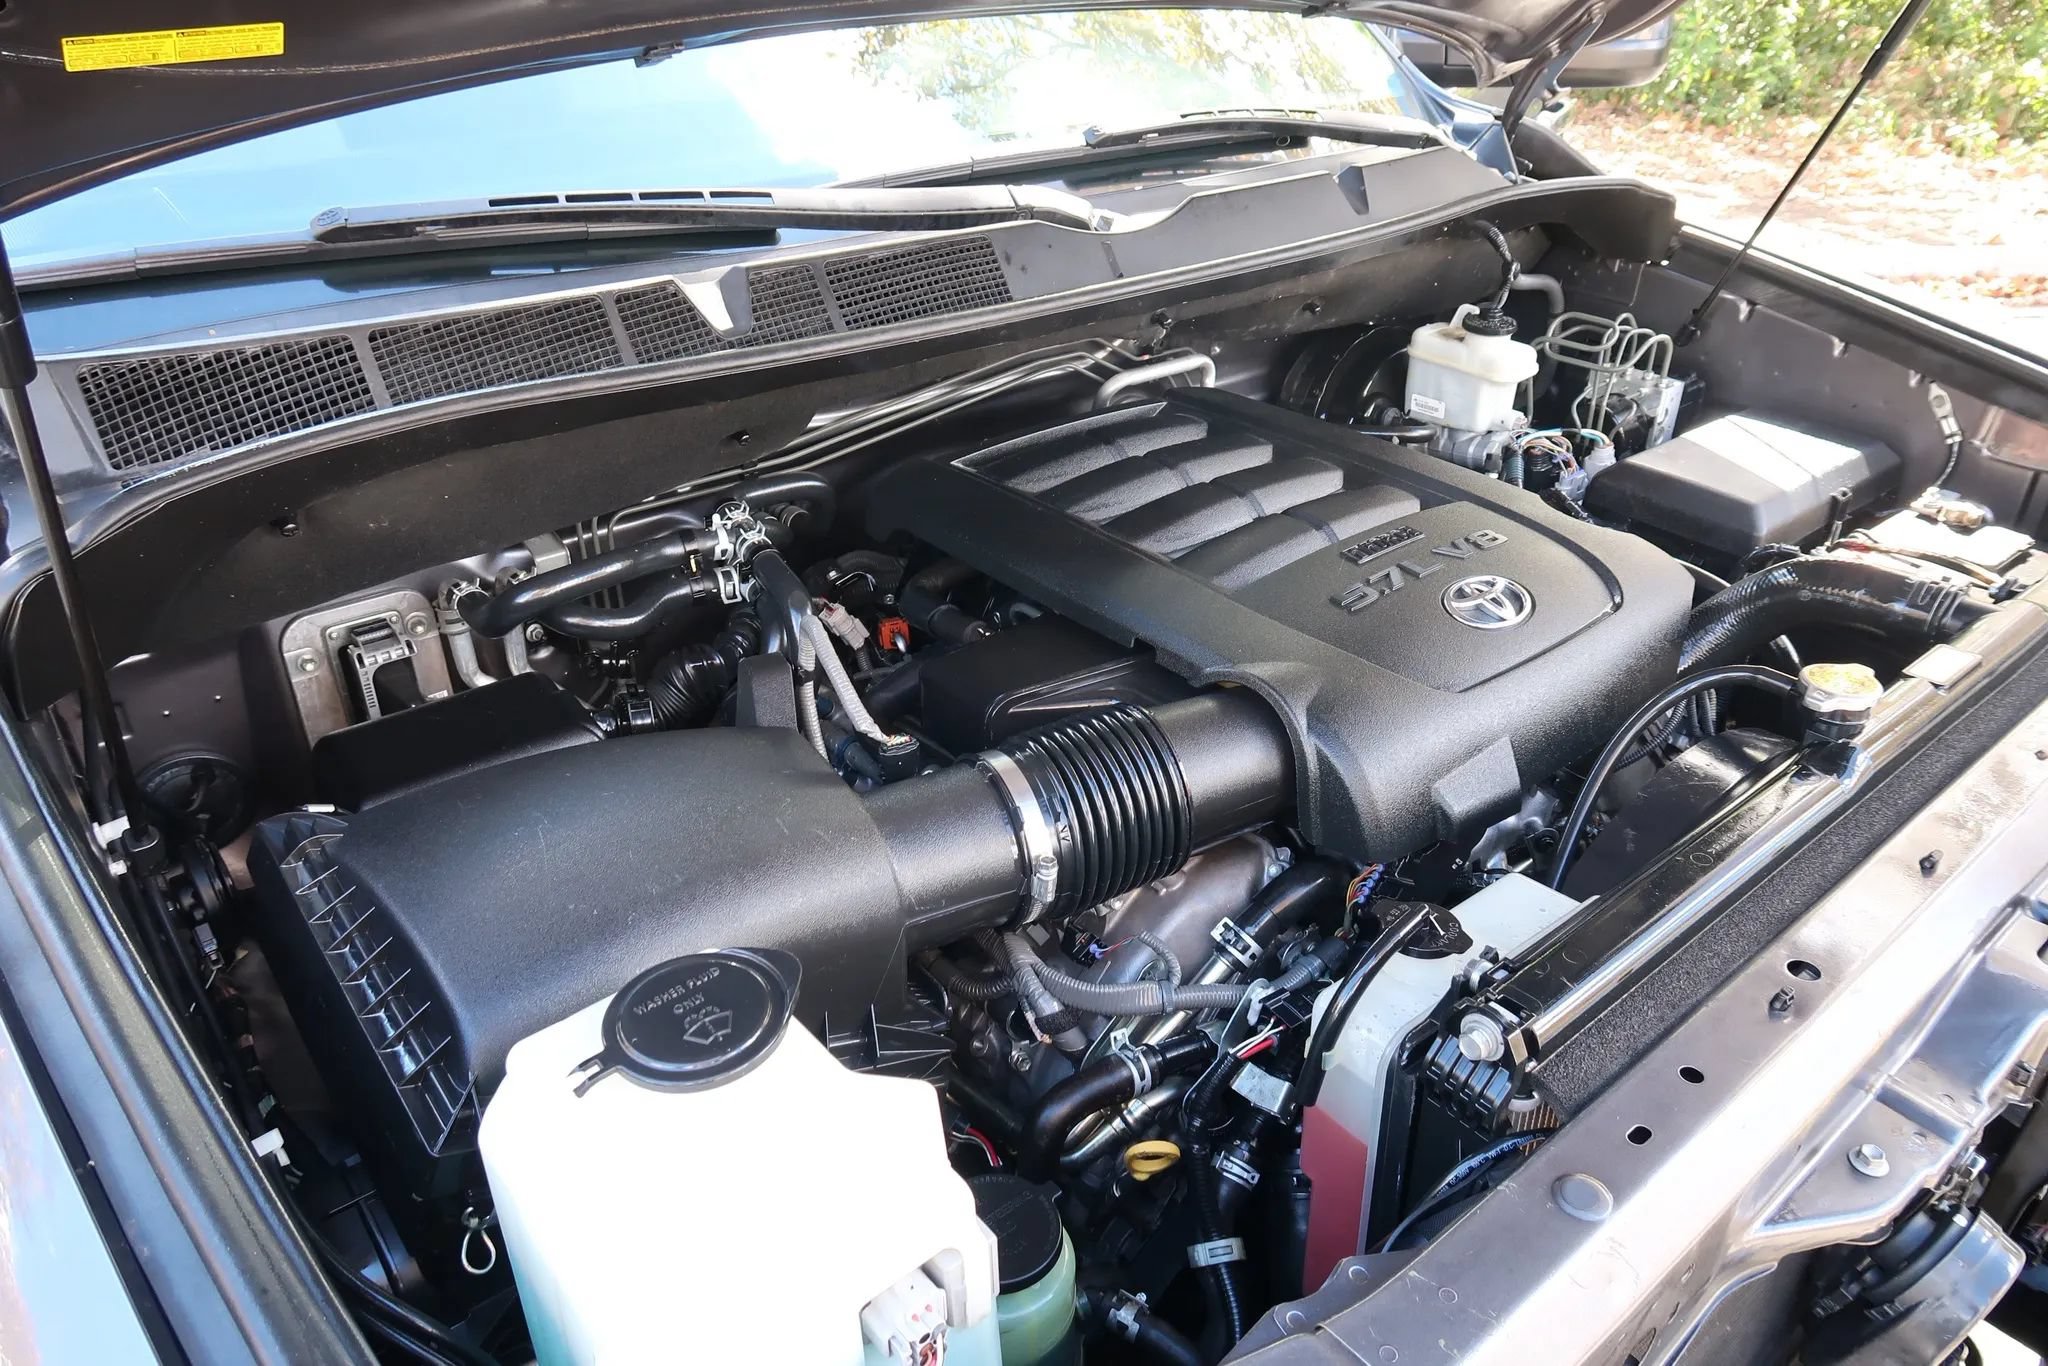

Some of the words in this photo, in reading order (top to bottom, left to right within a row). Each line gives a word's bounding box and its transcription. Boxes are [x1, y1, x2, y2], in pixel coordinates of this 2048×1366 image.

[1328, 559, 1446, 613] 5.7L
[1431, 529, 1509, 559] V8
[633, 984, 686, 1016] WASHER
[687, 967, 720, 989] FLUID
[673, 991, 705, 1014] ONLY
